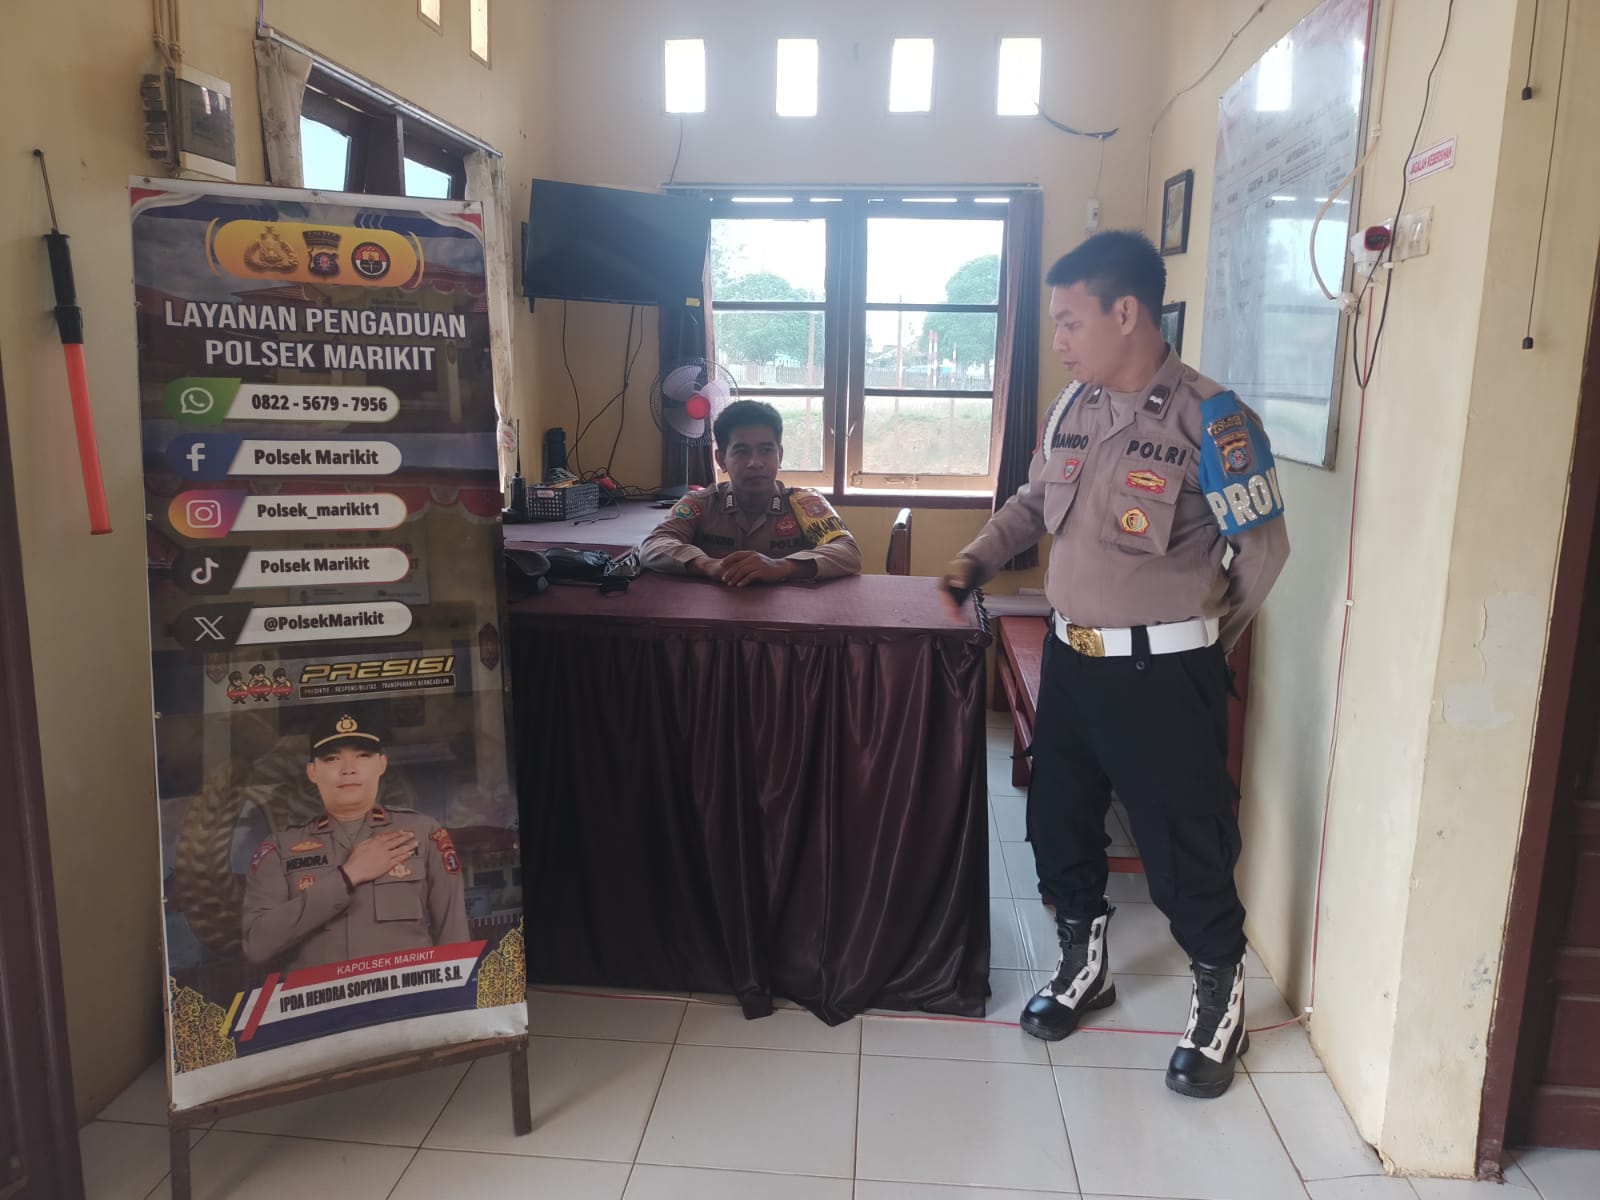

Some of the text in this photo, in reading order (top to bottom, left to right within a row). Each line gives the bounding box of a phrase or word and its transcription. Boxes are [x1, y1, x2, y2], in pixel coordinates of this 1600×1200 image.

[165, 301, 466, 338] LAYANAN PENGADUAN
[205, 340, 435, 371] POLSEK MARIKIT
[251, 393, 290, 411] 0822
[302, 394, 340, 412] 5679
[351, 396, 388, 412] 7956
[254, 448, 379, 465] Polsek Marikit
[1126, 439, 1187, 466] POLRI
[257, 502, 380, 520] Polsek_marikit1
[260, 557, 370, 574] Polsek Marikit
[263, 611, 384, 632] @PolsekMarikit
[300, 655, 456, 683] PRESISI
[286, 855, 329, 872] HENDRA
[337, 950, 435, 975] KAPOLSEK MARIKIT
[279, 994, 305, 1013] IPDA
[305, 985, 346, 1006] HENDRA
[347, 976, 389, 998] SOPIYAN
[390, 975, 401, 990] D.
[445, 965, 463, 981] S.H.
